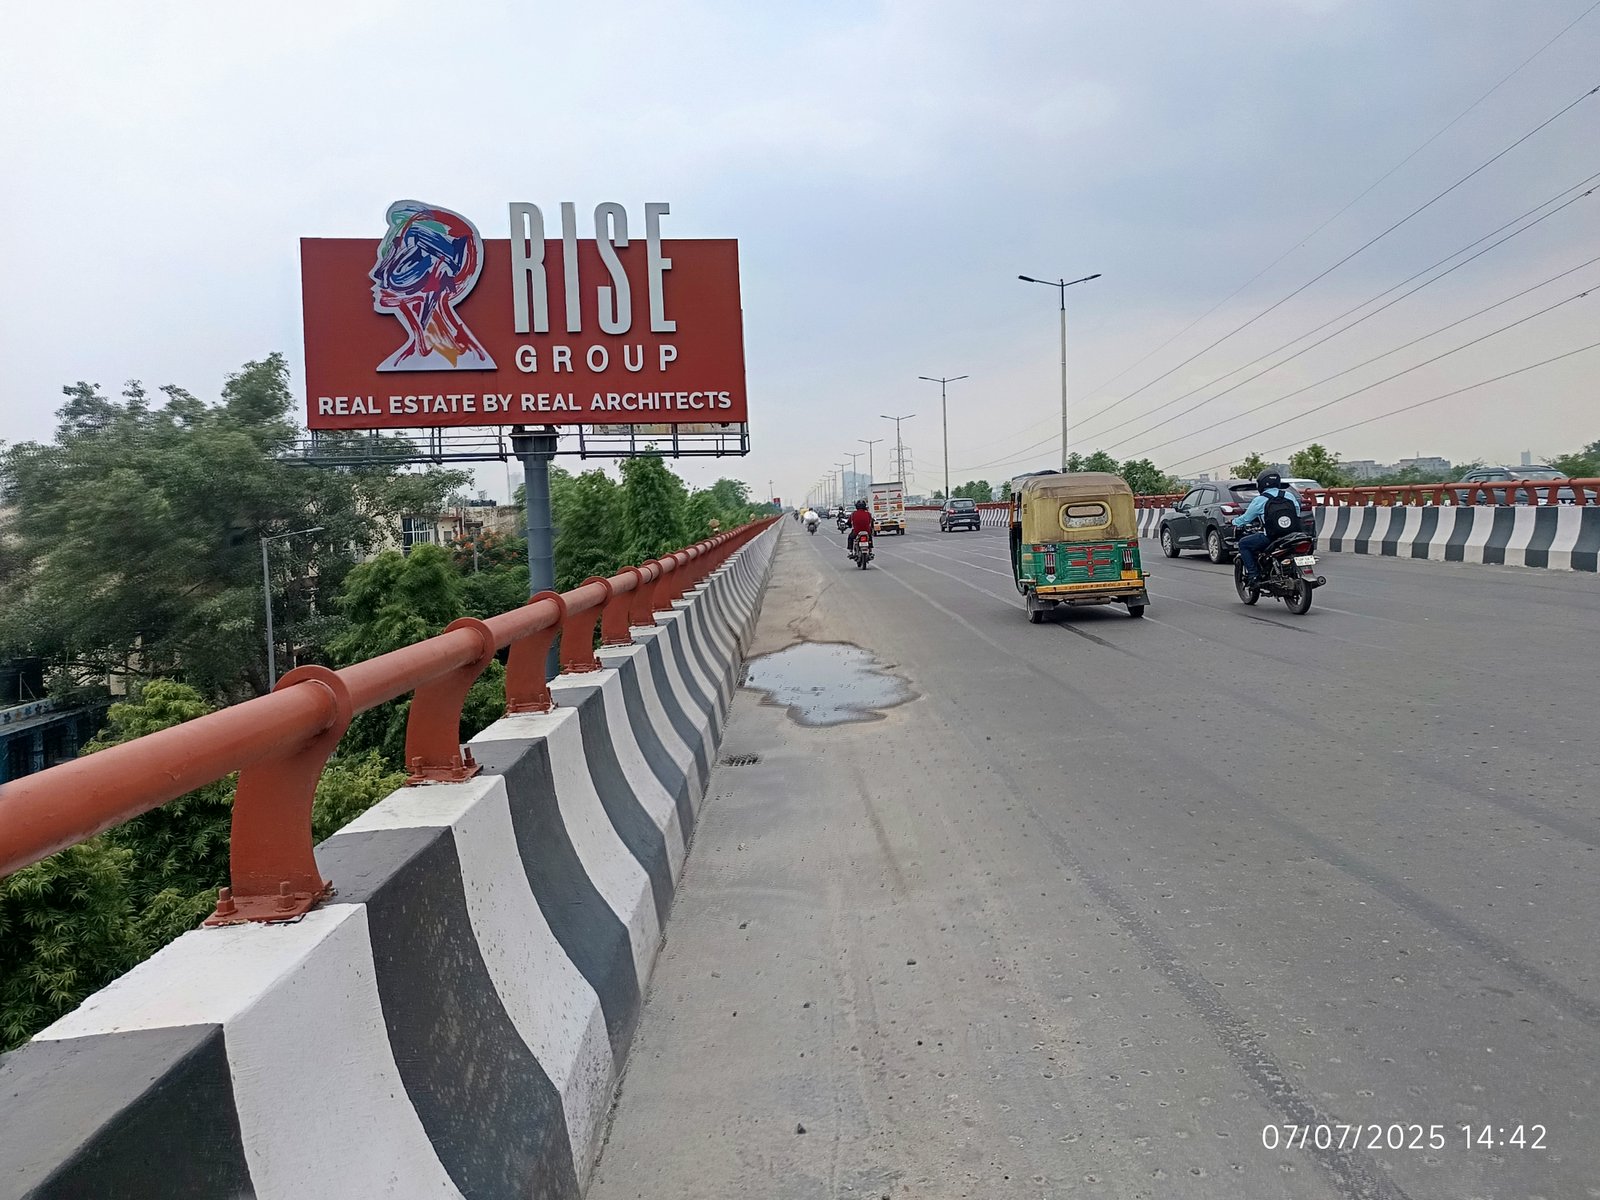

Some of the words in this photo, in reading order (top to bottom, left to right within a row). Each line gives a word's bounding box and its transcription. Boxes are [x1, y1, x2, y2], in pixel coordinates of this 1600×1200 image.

[509, 202, 677, 335] RISE
[515, 344, 678, 373] GROUP
[318, 395, 382, 416] REAL
[389, 394, 476, 414] ESTATE
[482, 393, 513, 412] BY
[520, 393, 582, 411] REAL
[590, 391, 732, 411] ARCHITECTS
